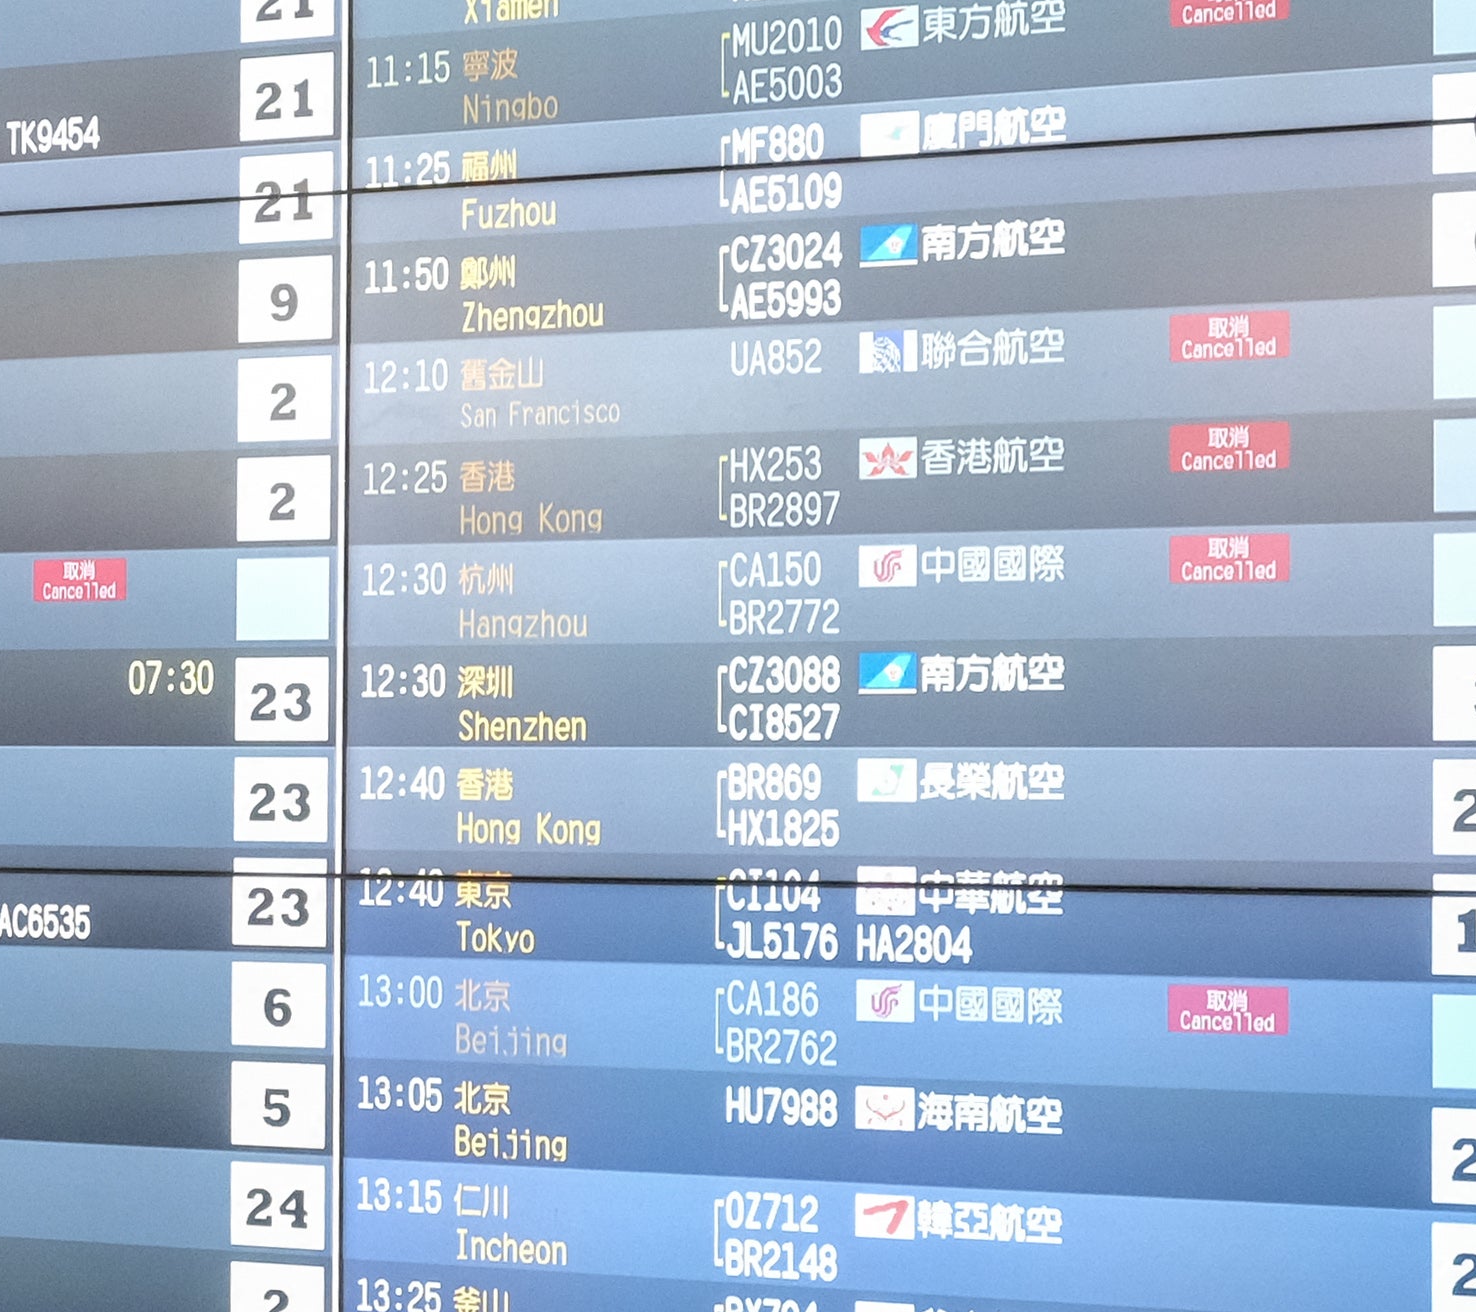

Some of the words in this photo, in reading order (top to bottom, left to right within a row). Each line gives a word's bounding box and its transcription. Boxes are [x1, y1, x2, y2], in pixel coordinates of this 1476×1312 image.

[6, 115, 101, 155] TK9454
[462, 197, 557, 231] Fuzhou
[921, 217, 1066, 262] 南方航空
[364, 256, 449, 294] 11:50
[270, 283, 298, 322] 9
[731, 337, 822, 377] UA852
[460, 402, 497, 429] San
[509, 399, 620, 426] Francisco
[921, 435, 1065, 475] 香港航空
[42, 581, 116, 600] Cancelled
[729, 598, 840, 635] BR2772
[128, 659, 214, 696] 07:30
[458, 709, 587, 741] Shenzhen
[360, 765, 446, 801] 12:40
[457, 811, 521, 845] Hong
[537, 812, 601, 846] Kong
[456, 920, 535, 953] Tokyo
[263, 988, 292, 1028] 6
[919, 983, 1063, 1025] 中國國際
[263, 1088, 291, 1128] 5
[725, 1085, 838, 1127] HU7988
[245, 1187, 308, 1229] 24
[456, 1227, 567, 1266] Incheon
